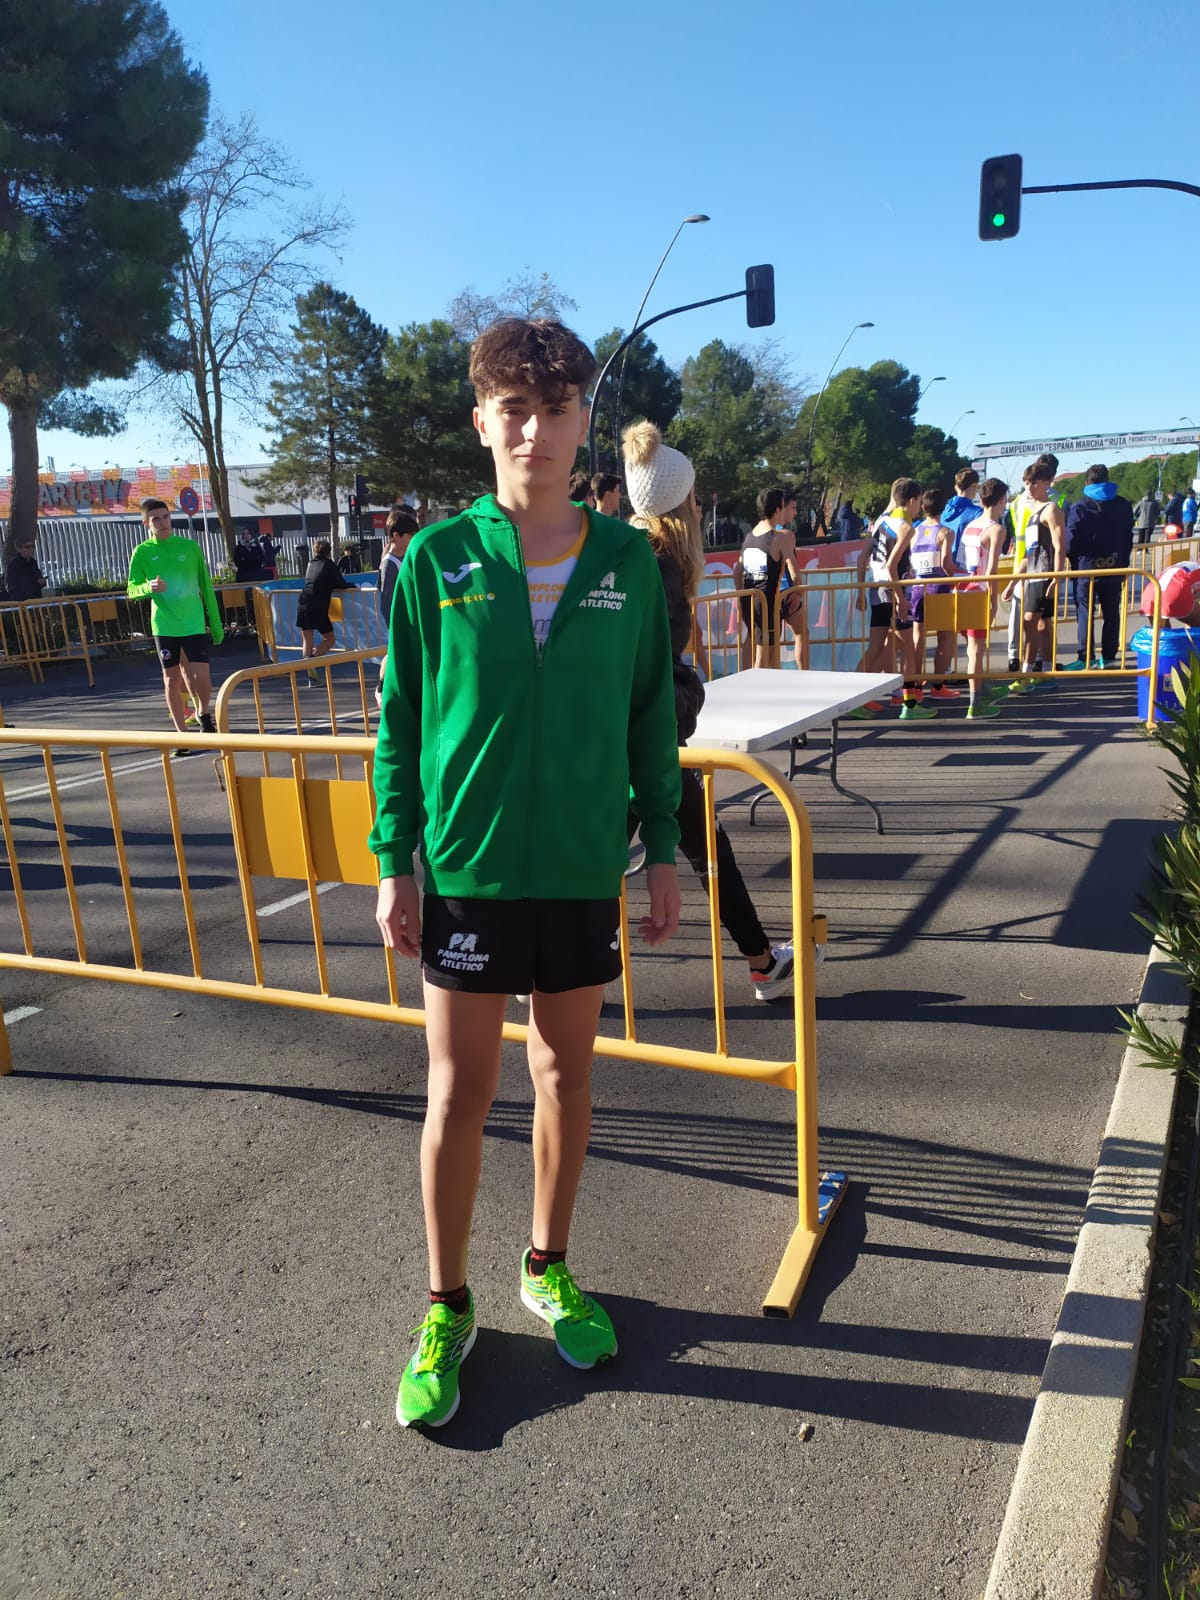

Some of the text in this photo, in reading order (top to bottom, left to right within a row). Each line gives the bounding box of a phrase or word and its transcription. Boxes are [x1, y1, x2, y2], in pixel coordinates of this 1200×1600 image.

[1000, 443, 1043, 454] CAMPEONATO
[1048, 439, 1074, 451] ESPAÑA
[1075, 438, 1104, 449] MARCHA
[1109, 437, 1127, 446] RUTA
[39, 479, 121, 507] ARIETY
[920, 559, 930, 567] 10
[587, 590, 627, 601] MPLONA
[578, 599, 623, 611] ATLETICO
[448, 932, 478, 952] PA
[437, 948, 490, 962] PAMPLONA
[440, 958, 484, 971] ATLETICO
